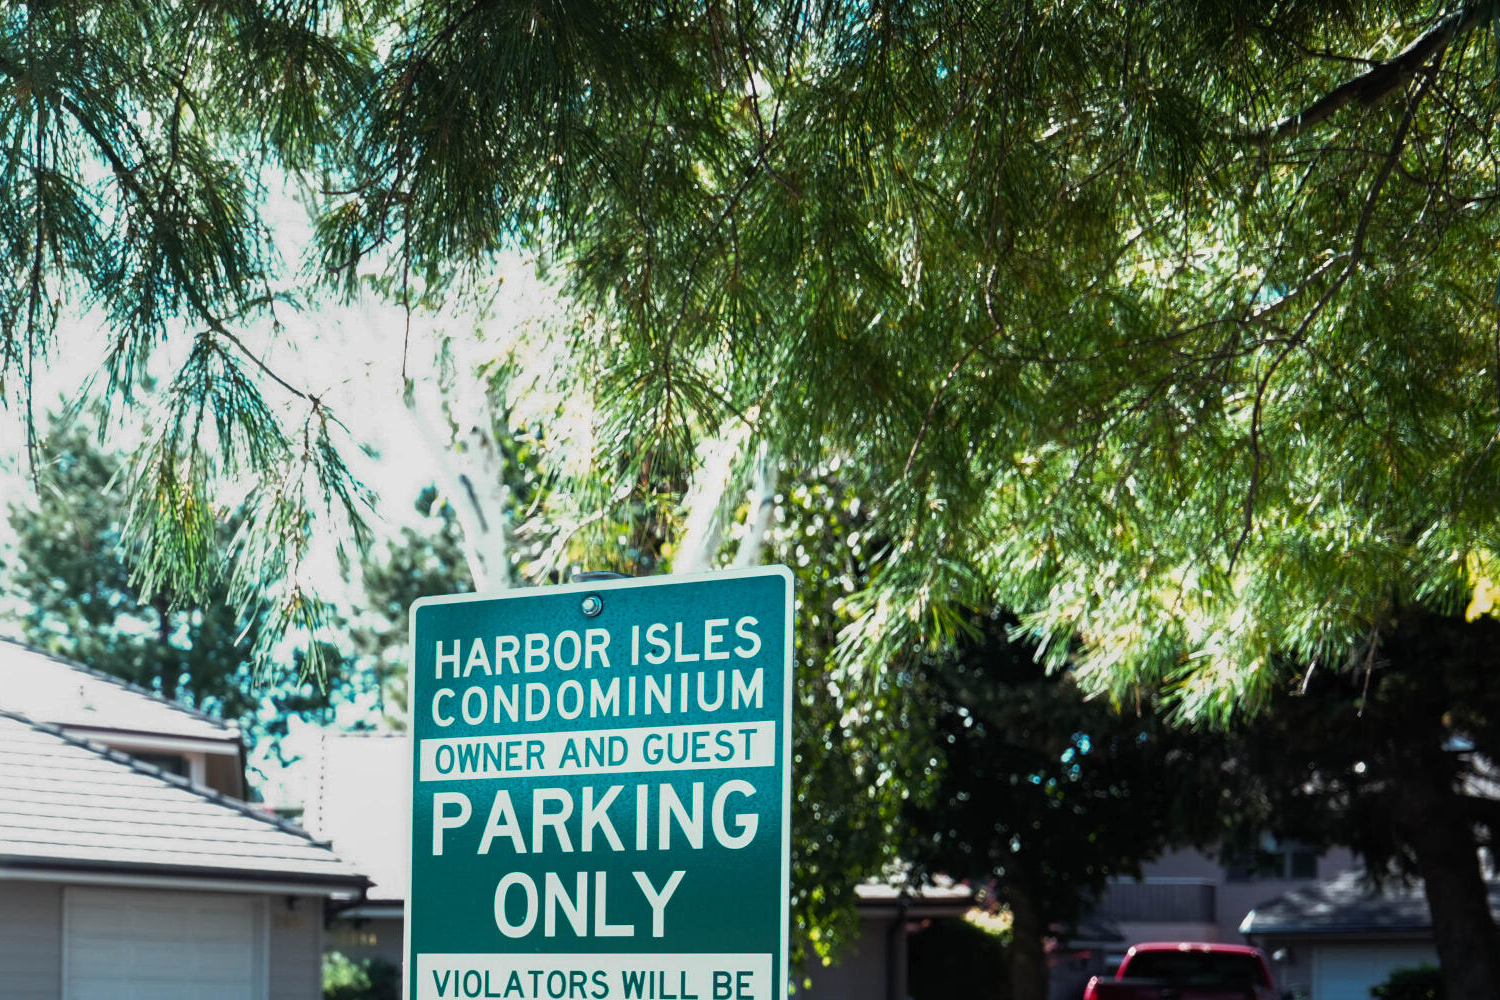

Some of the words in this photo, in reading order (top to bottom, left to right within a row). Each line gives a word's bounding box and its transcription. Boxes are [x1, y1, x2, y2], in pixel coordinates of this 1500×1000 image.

[434, 627, 611, 679] HARBOR
[631, 616, 761, 665] ISLES
[431, 668, 763, 727] CONDOMINIUM
[434, 739, 545, 774] OWNER
[559, 736, 629, 769] AND
[643, 728, 758, 765] GUEST
[432, 780, 759, 856] PARKING
[493, 870, 686, 938] ONLY
[432, 970, 610, 1000] VIOLATORS
[621, 971, 698, 1000] WILL
[713, 971, 755, 1000] BE
